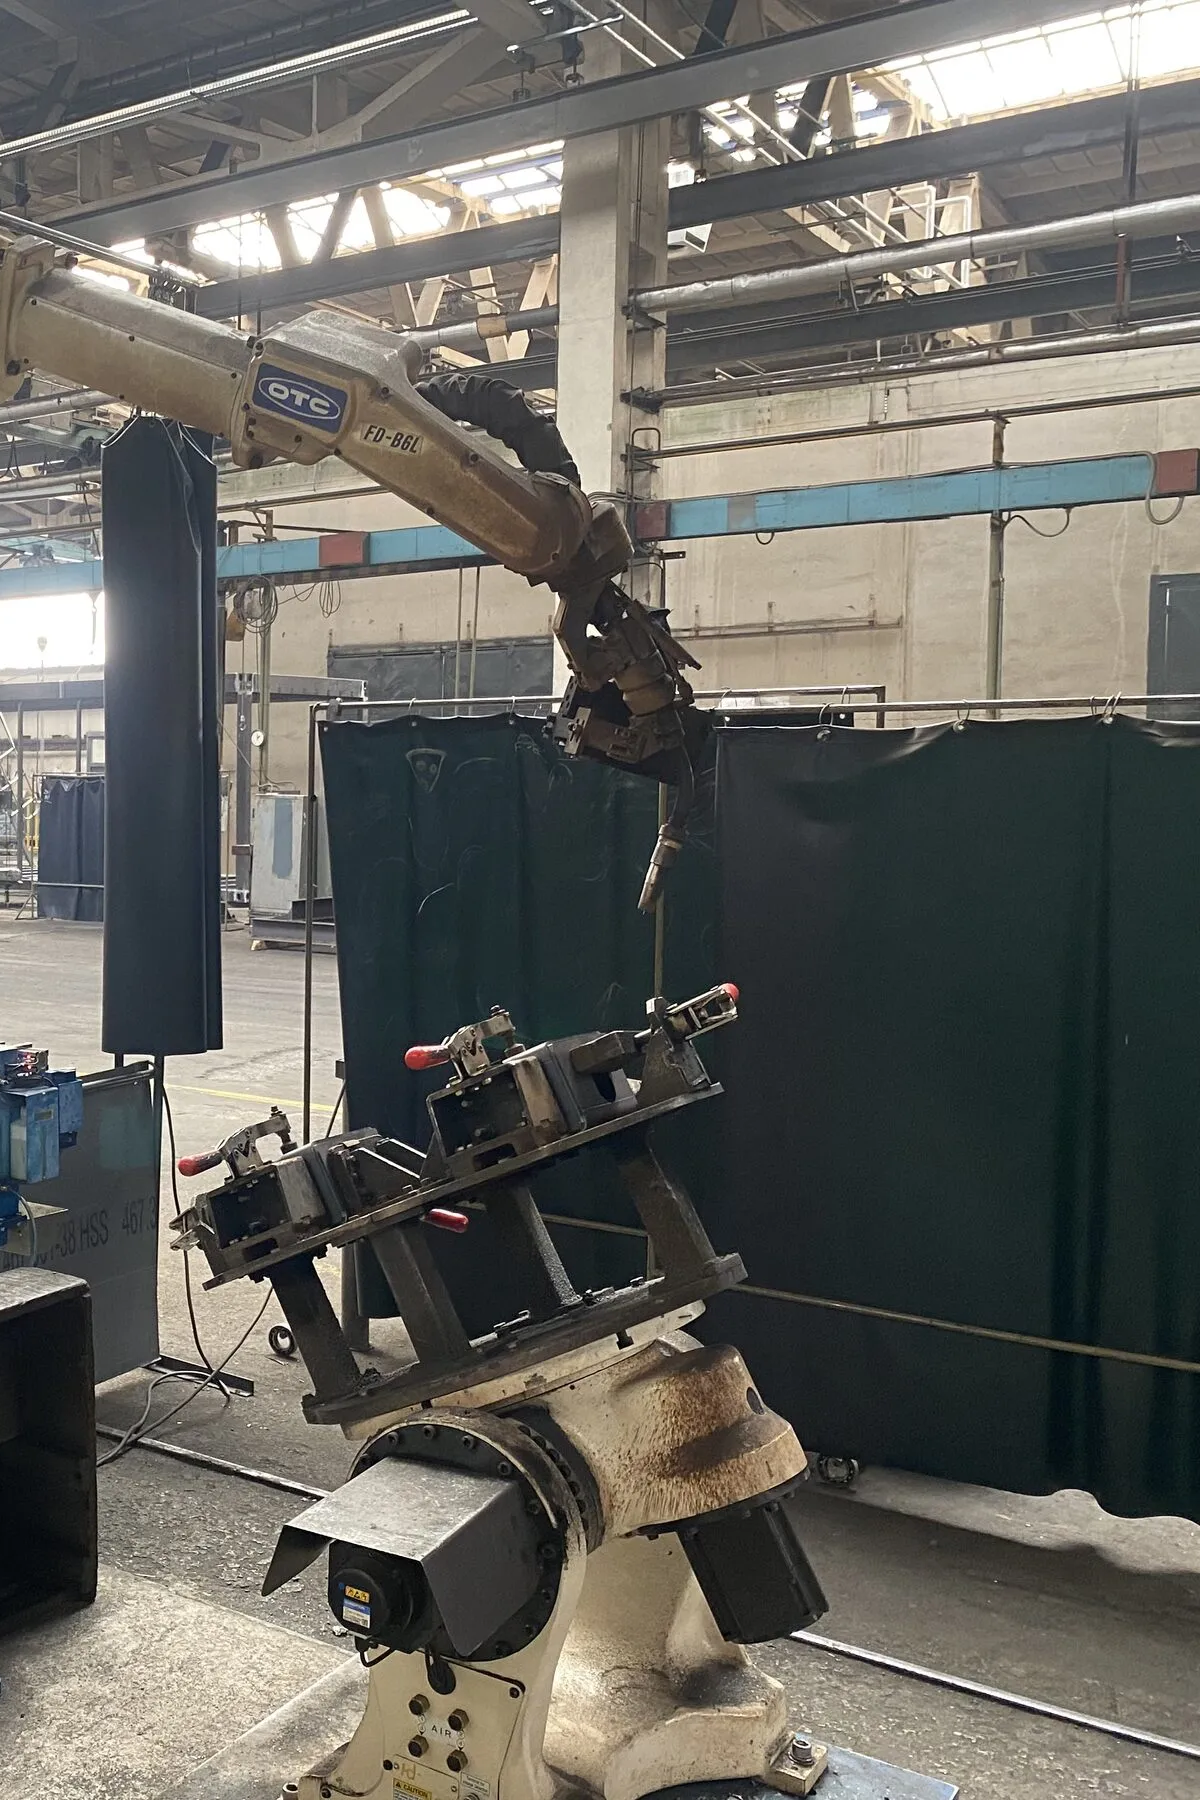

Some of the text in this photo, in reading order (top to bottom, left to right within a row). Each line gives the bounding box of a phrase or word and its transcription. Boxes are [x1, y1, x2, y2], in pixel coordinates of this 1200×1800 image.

[268, 382, 331, 415] OTC
[363, 424, 420, 454] FD-B6L
[80, 1208, 109, 1252] HSS
[431, 1724, 452, 1738] AIR
[403, 1784, 429, 1799] CAUTION
